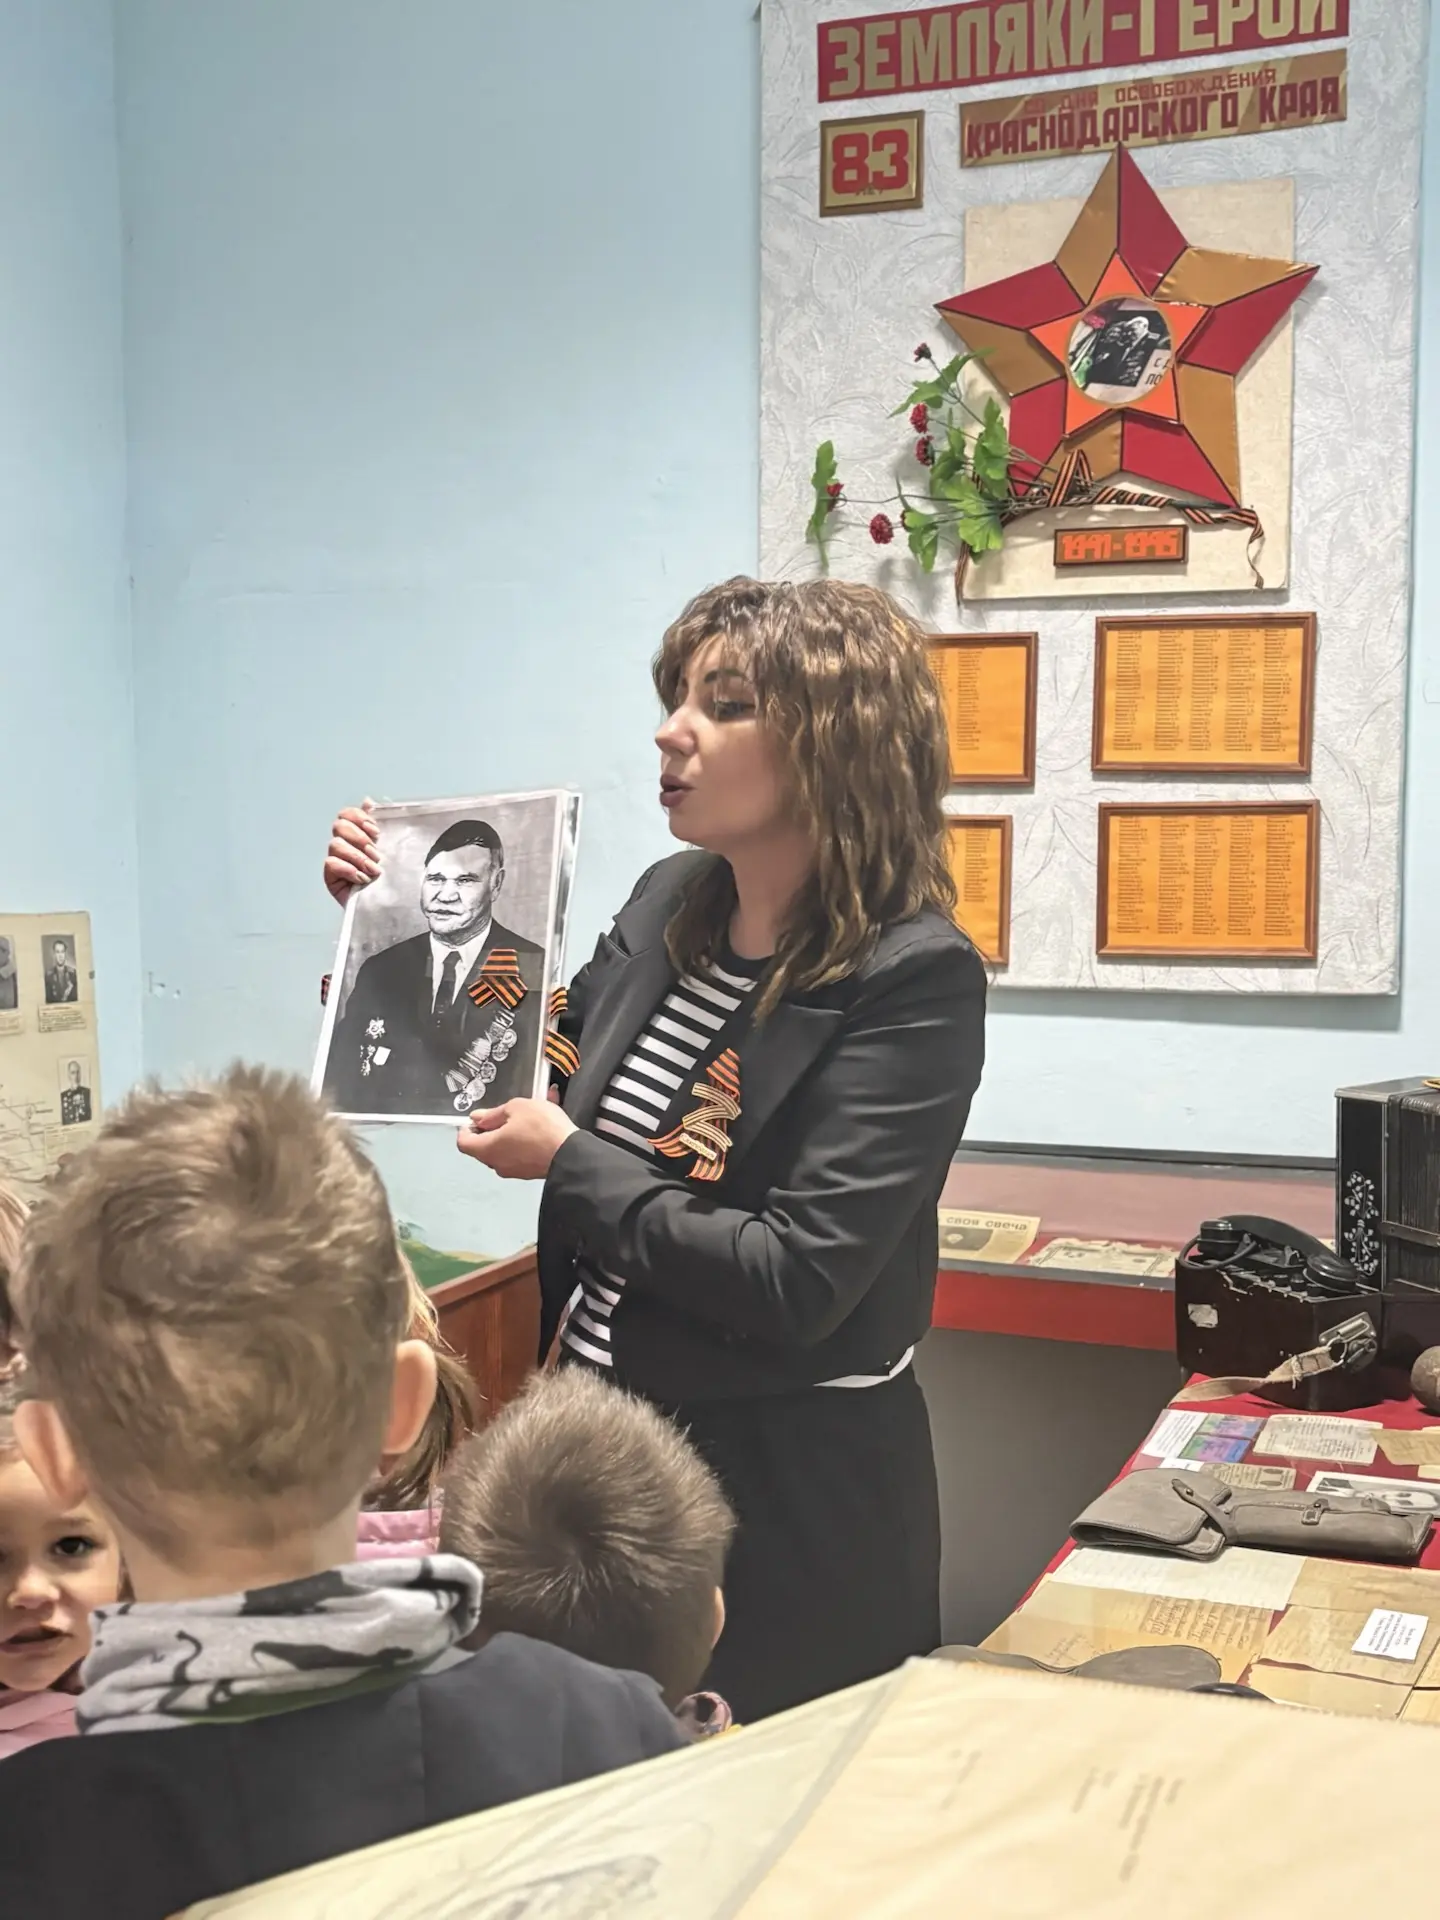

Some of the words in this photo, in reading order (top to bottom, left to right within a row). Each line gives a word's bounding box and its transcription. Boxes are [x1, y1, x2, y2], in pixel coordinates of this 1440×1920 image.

[1115, 69, 1277, 103] ОСВОБОЖДЕНИЯ
[966, 92, 1239, 158] КРАСНОДАРСКОГО
[1259, 76, 1340, 124] КРАЯ
[832, 129, 909, 195] 83
[946, 1216, 980, 1226] своя
[984, 1220, 1028, 1231] свеча
